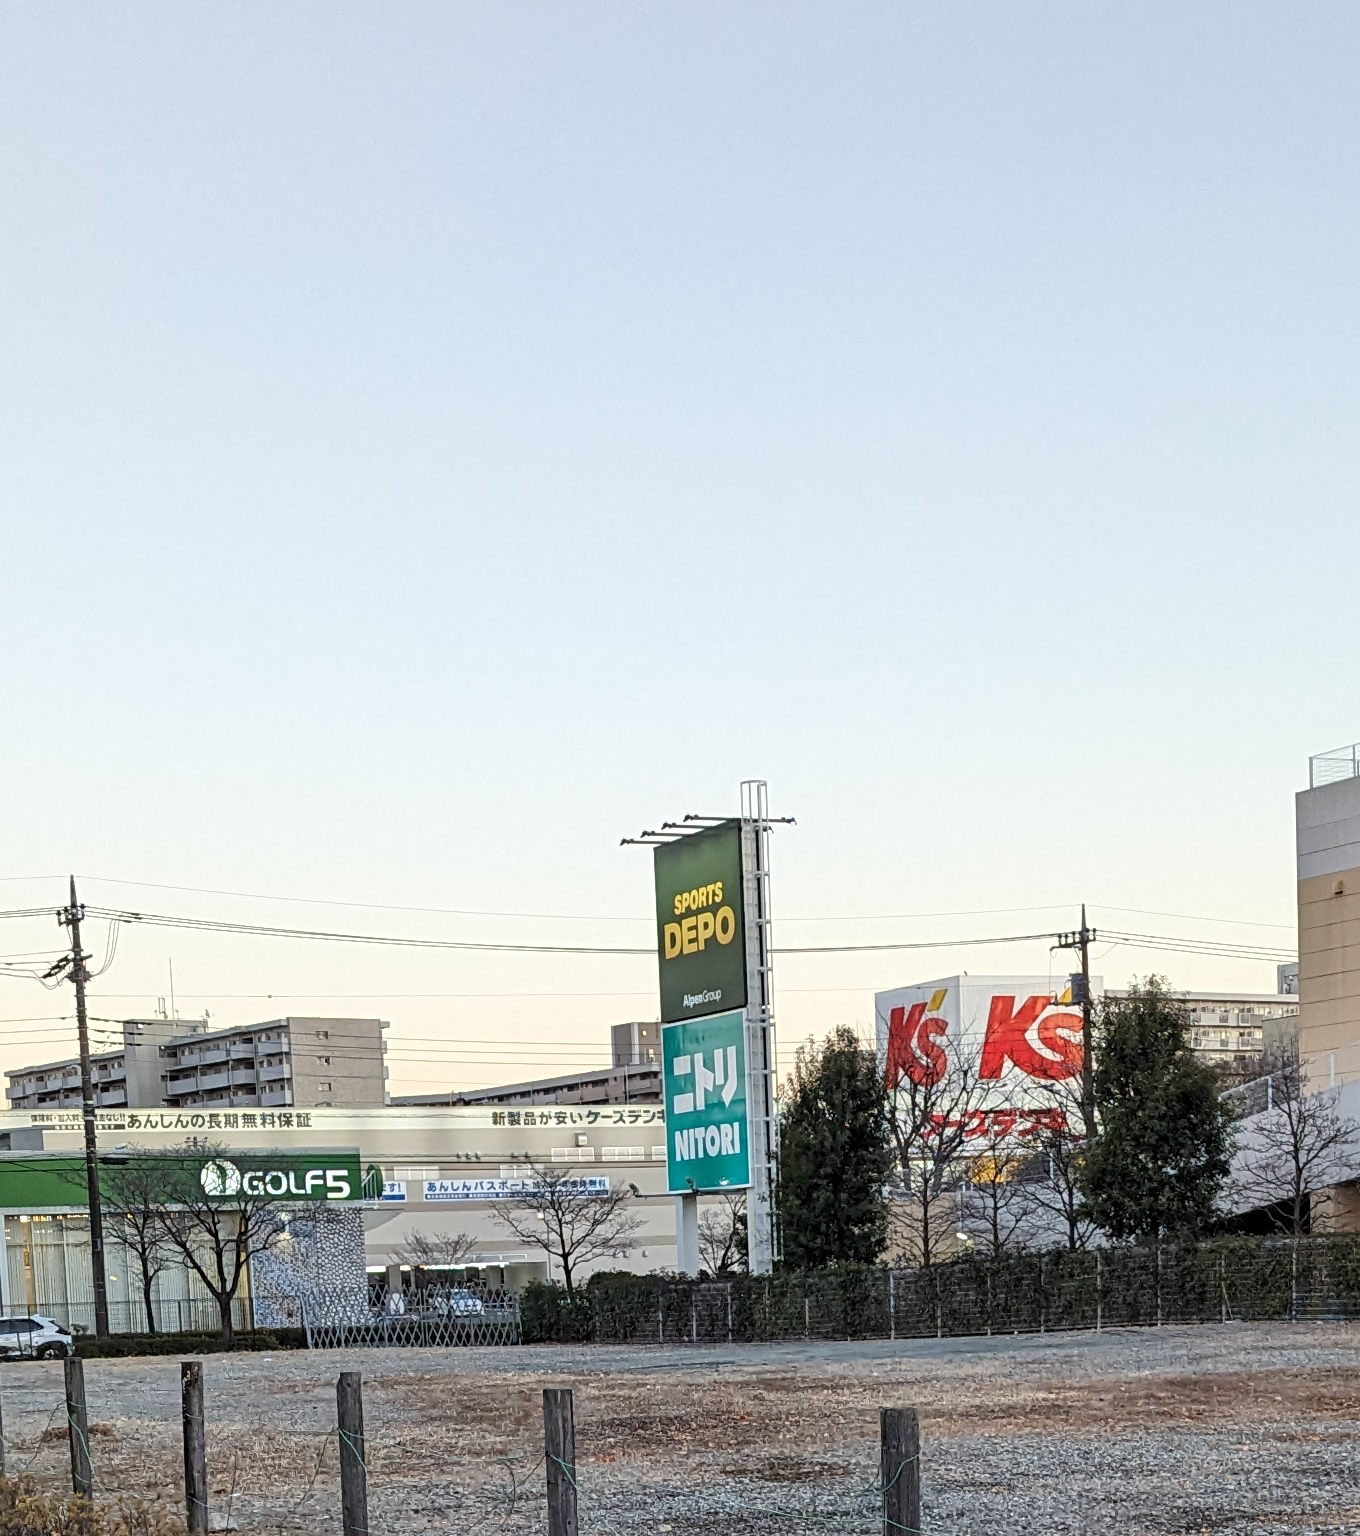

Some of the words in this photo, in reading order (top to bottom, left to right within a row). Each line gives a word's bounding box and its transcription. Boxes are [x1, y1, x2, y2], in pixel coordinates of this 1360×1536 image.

[674, 882, 723, 915] SPORTS
[664, 906, 735, 959] DEPO
[673, 1045, 737, 1115] ニトリ
[127, 1113, 313, 1129] あんしんの長期無料保証
[674, 1121, 741, 1161] NITORI
